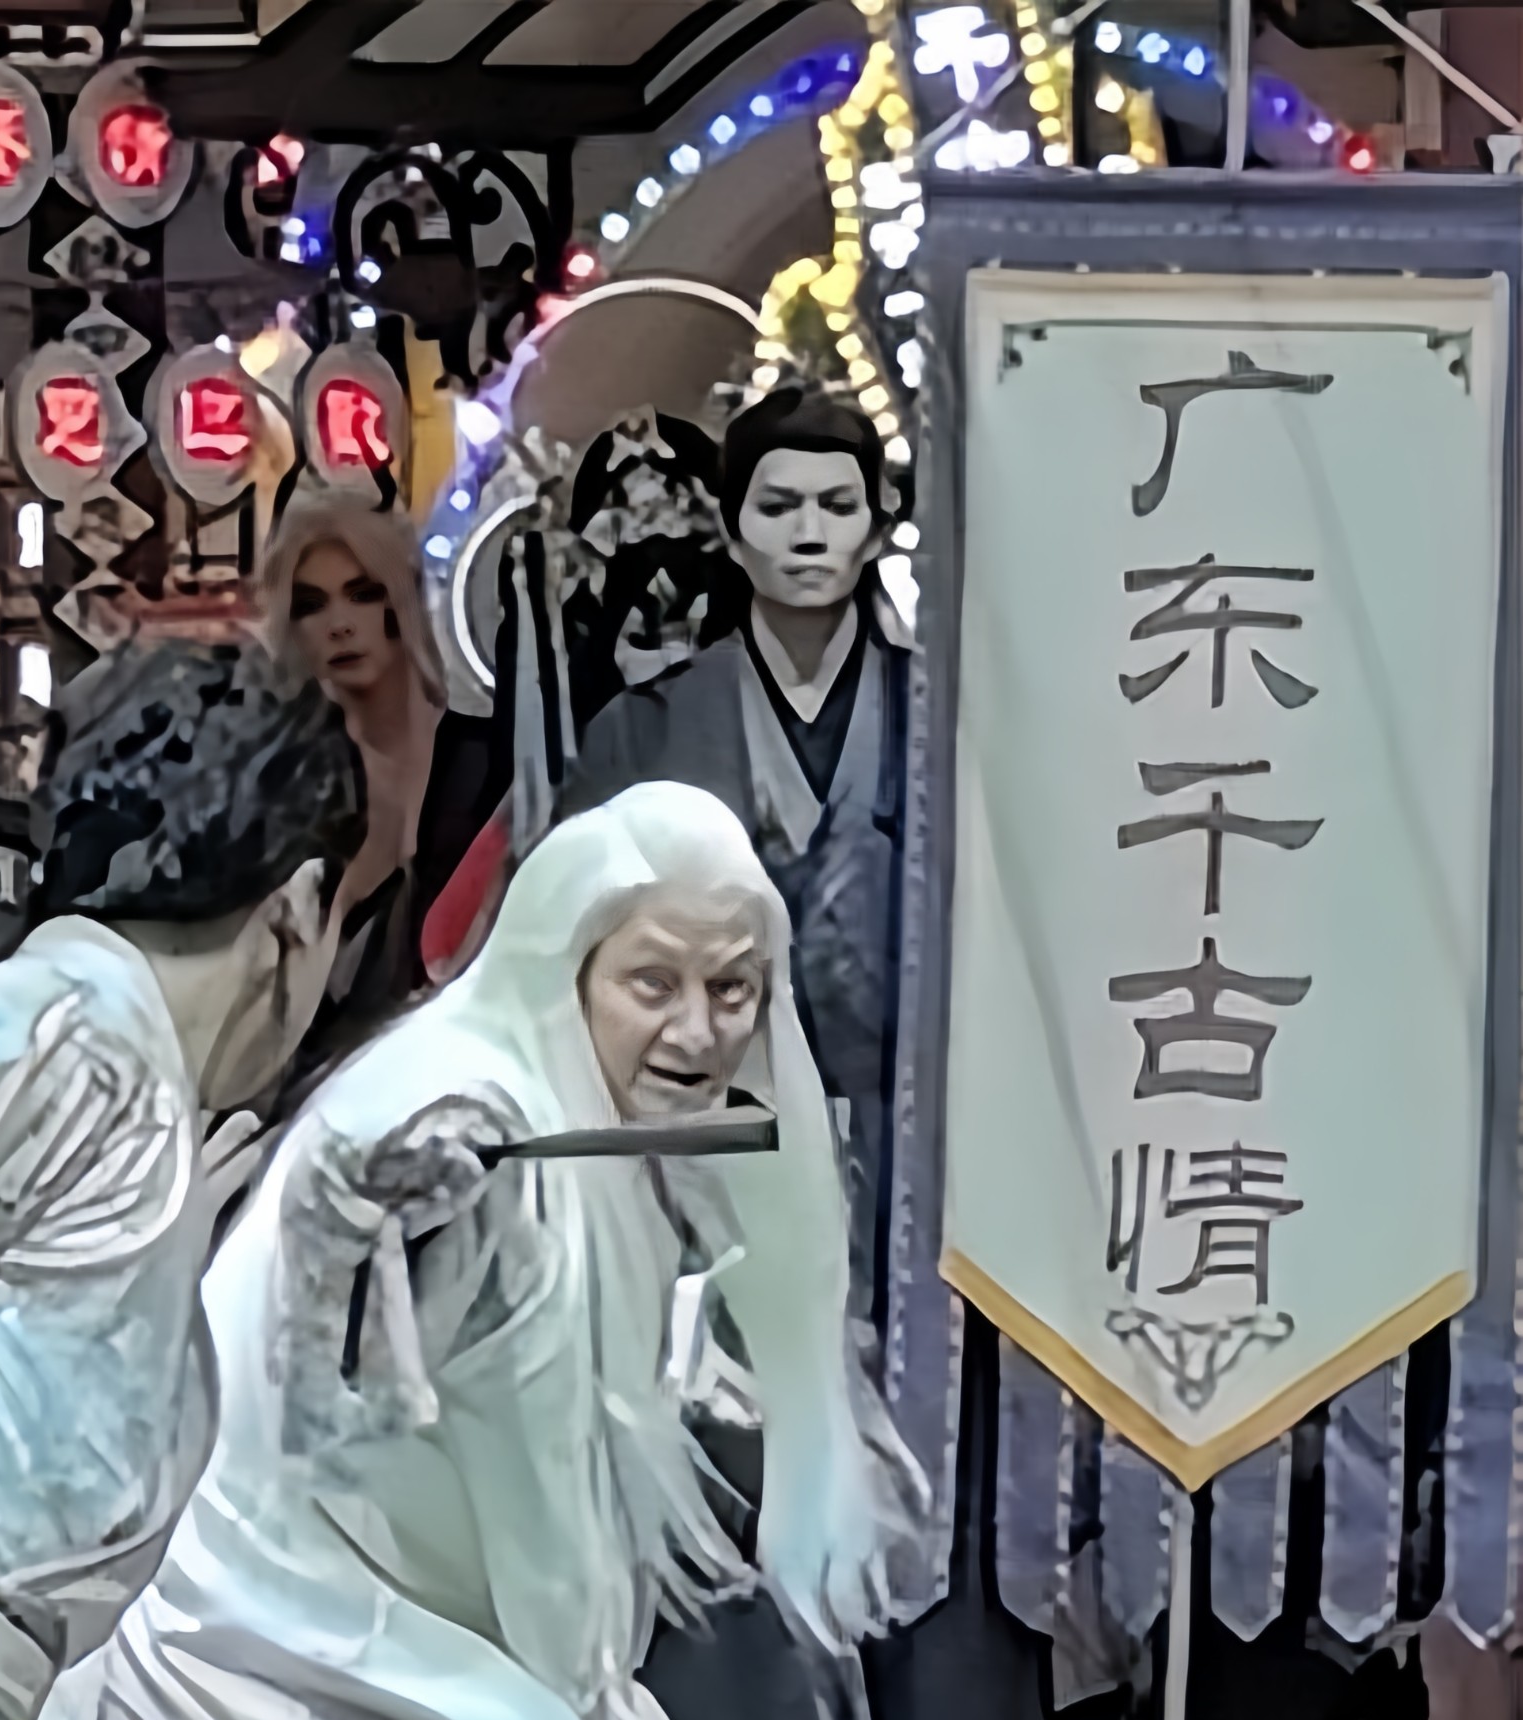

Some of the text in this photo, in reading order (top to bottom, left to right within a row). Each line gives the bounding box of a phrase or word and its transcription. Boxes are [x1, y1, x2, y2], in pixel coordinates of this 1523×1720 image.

[1106, 349, 1335, 1305] 广东千古情
